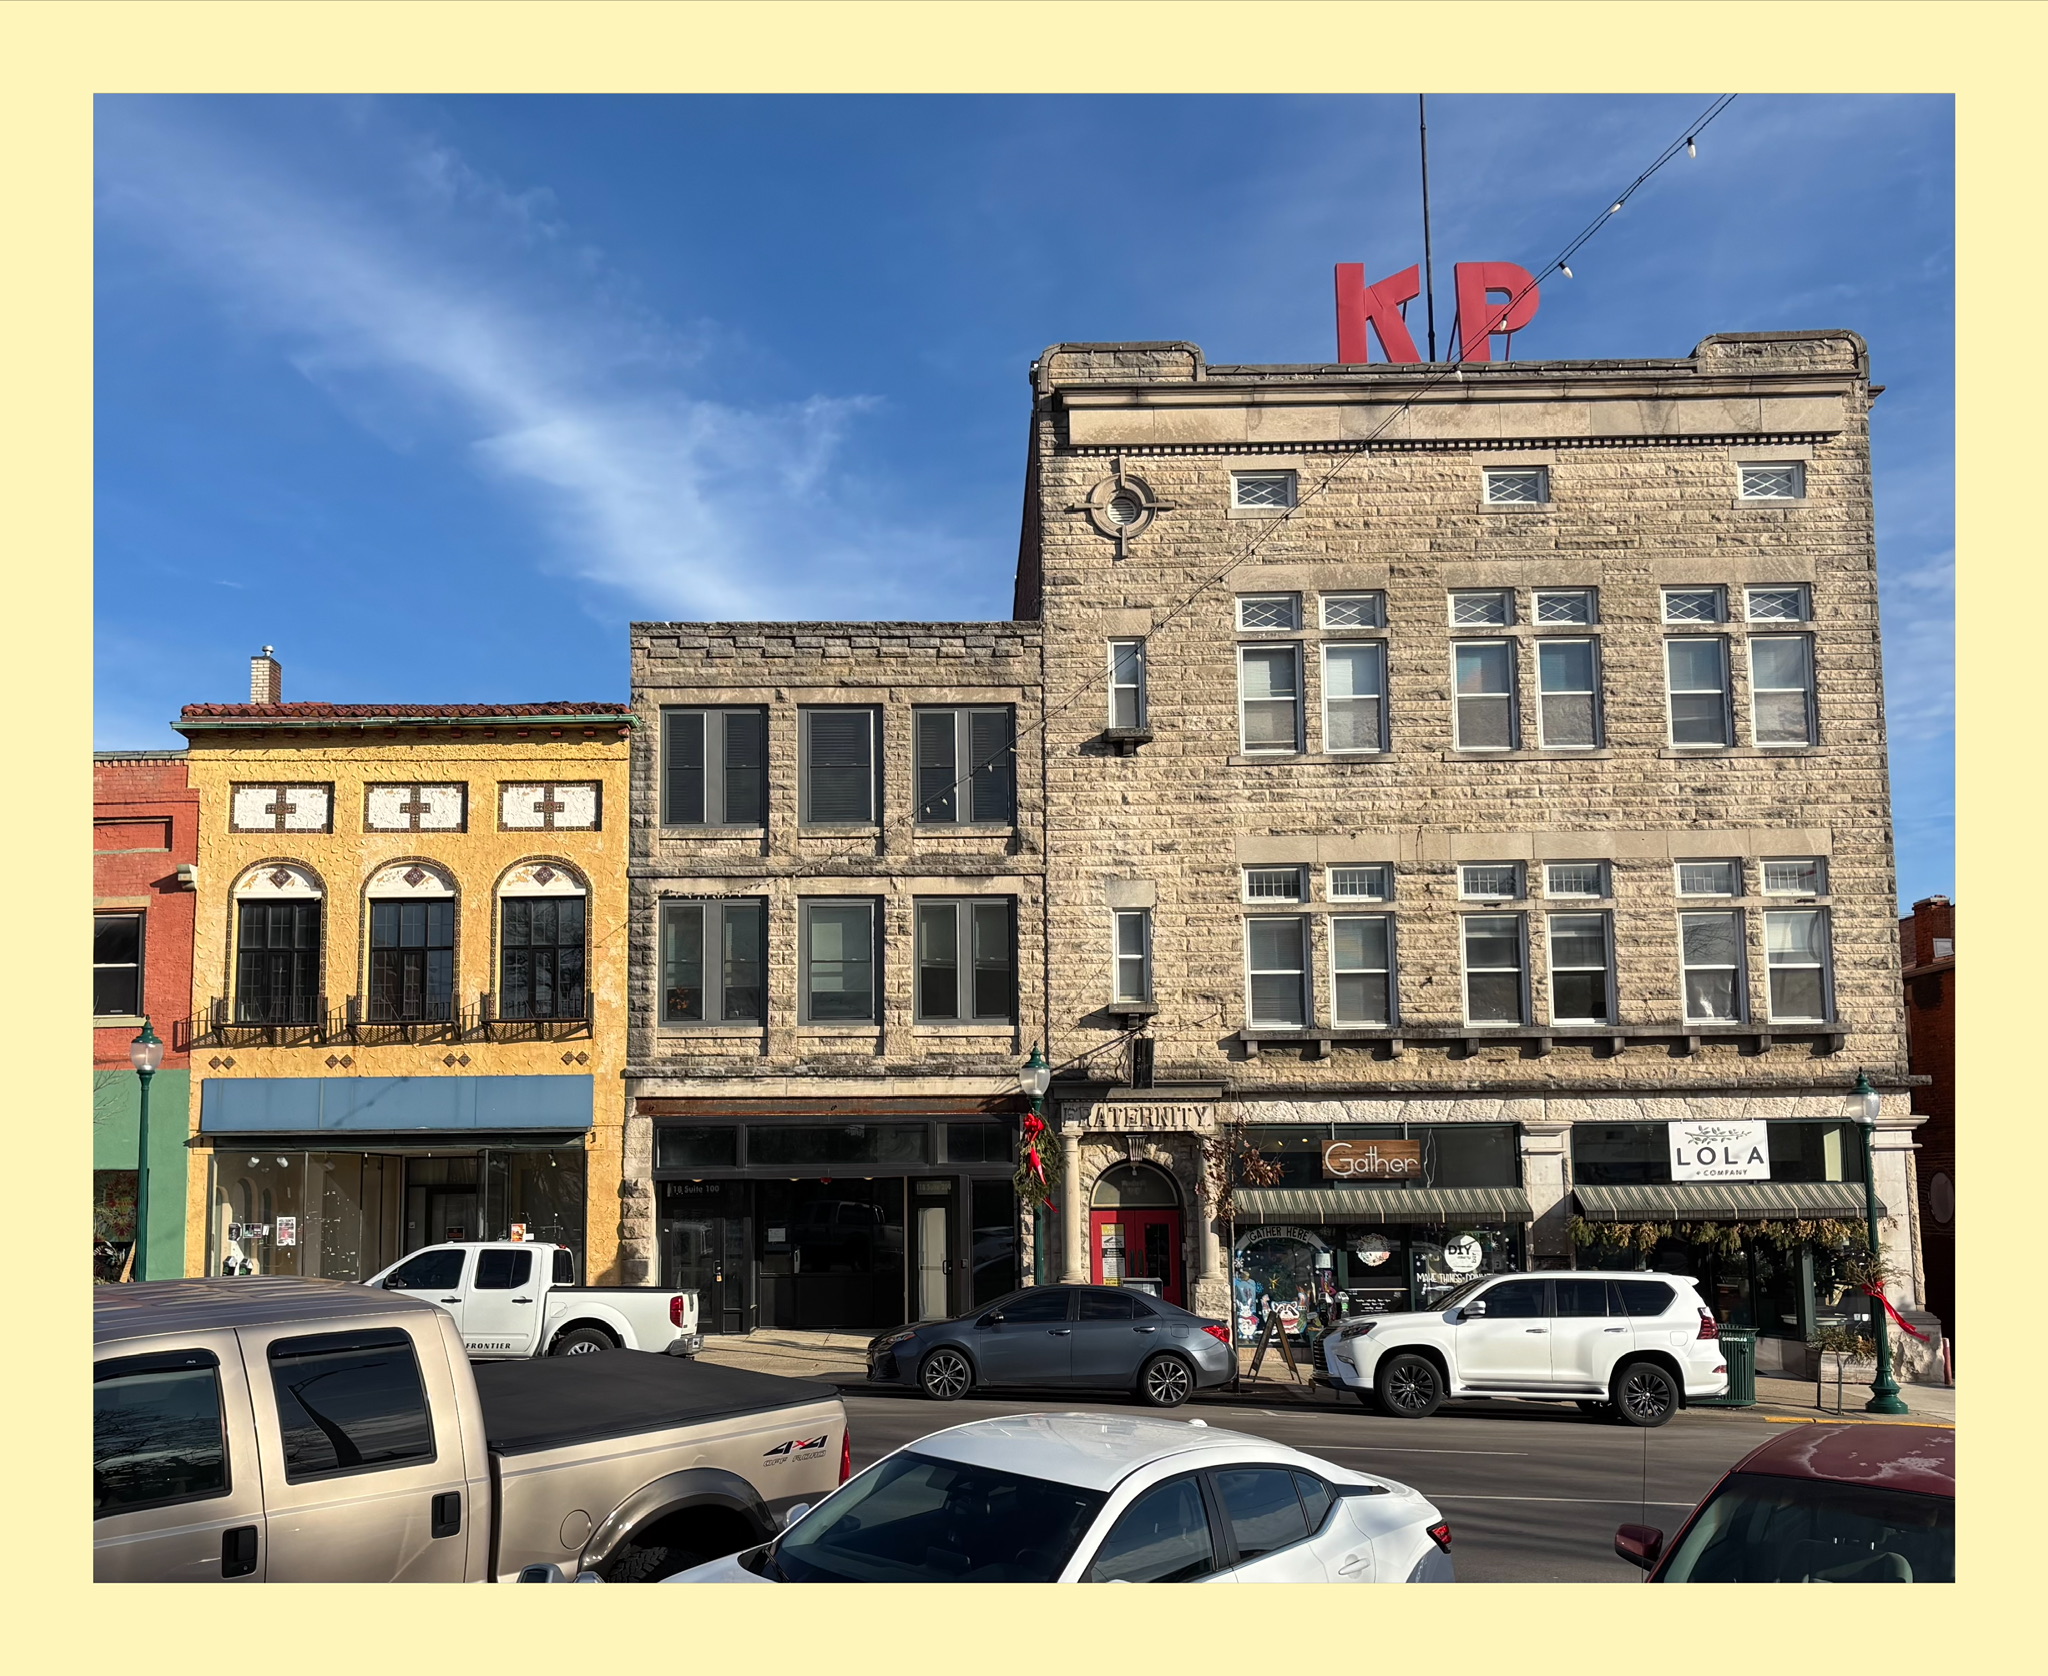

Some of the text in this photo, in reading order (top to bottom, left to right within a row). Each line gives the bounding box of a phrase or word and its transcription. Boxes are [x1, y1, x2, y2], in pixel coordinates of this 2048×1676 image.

[1335, 262, 1540, 363] K P
[1325, 1143, 1419, 1176] Gather
[1676, 1146, 1765, 1166] LOLA
[706, 1185, 720, 1193] 100
[1249, 1226, 1309, 1242] GATHER HERE
[1448, 1245, 1473, 1255] DIY
[465, 1342, 511, 1350] FRONTIER
